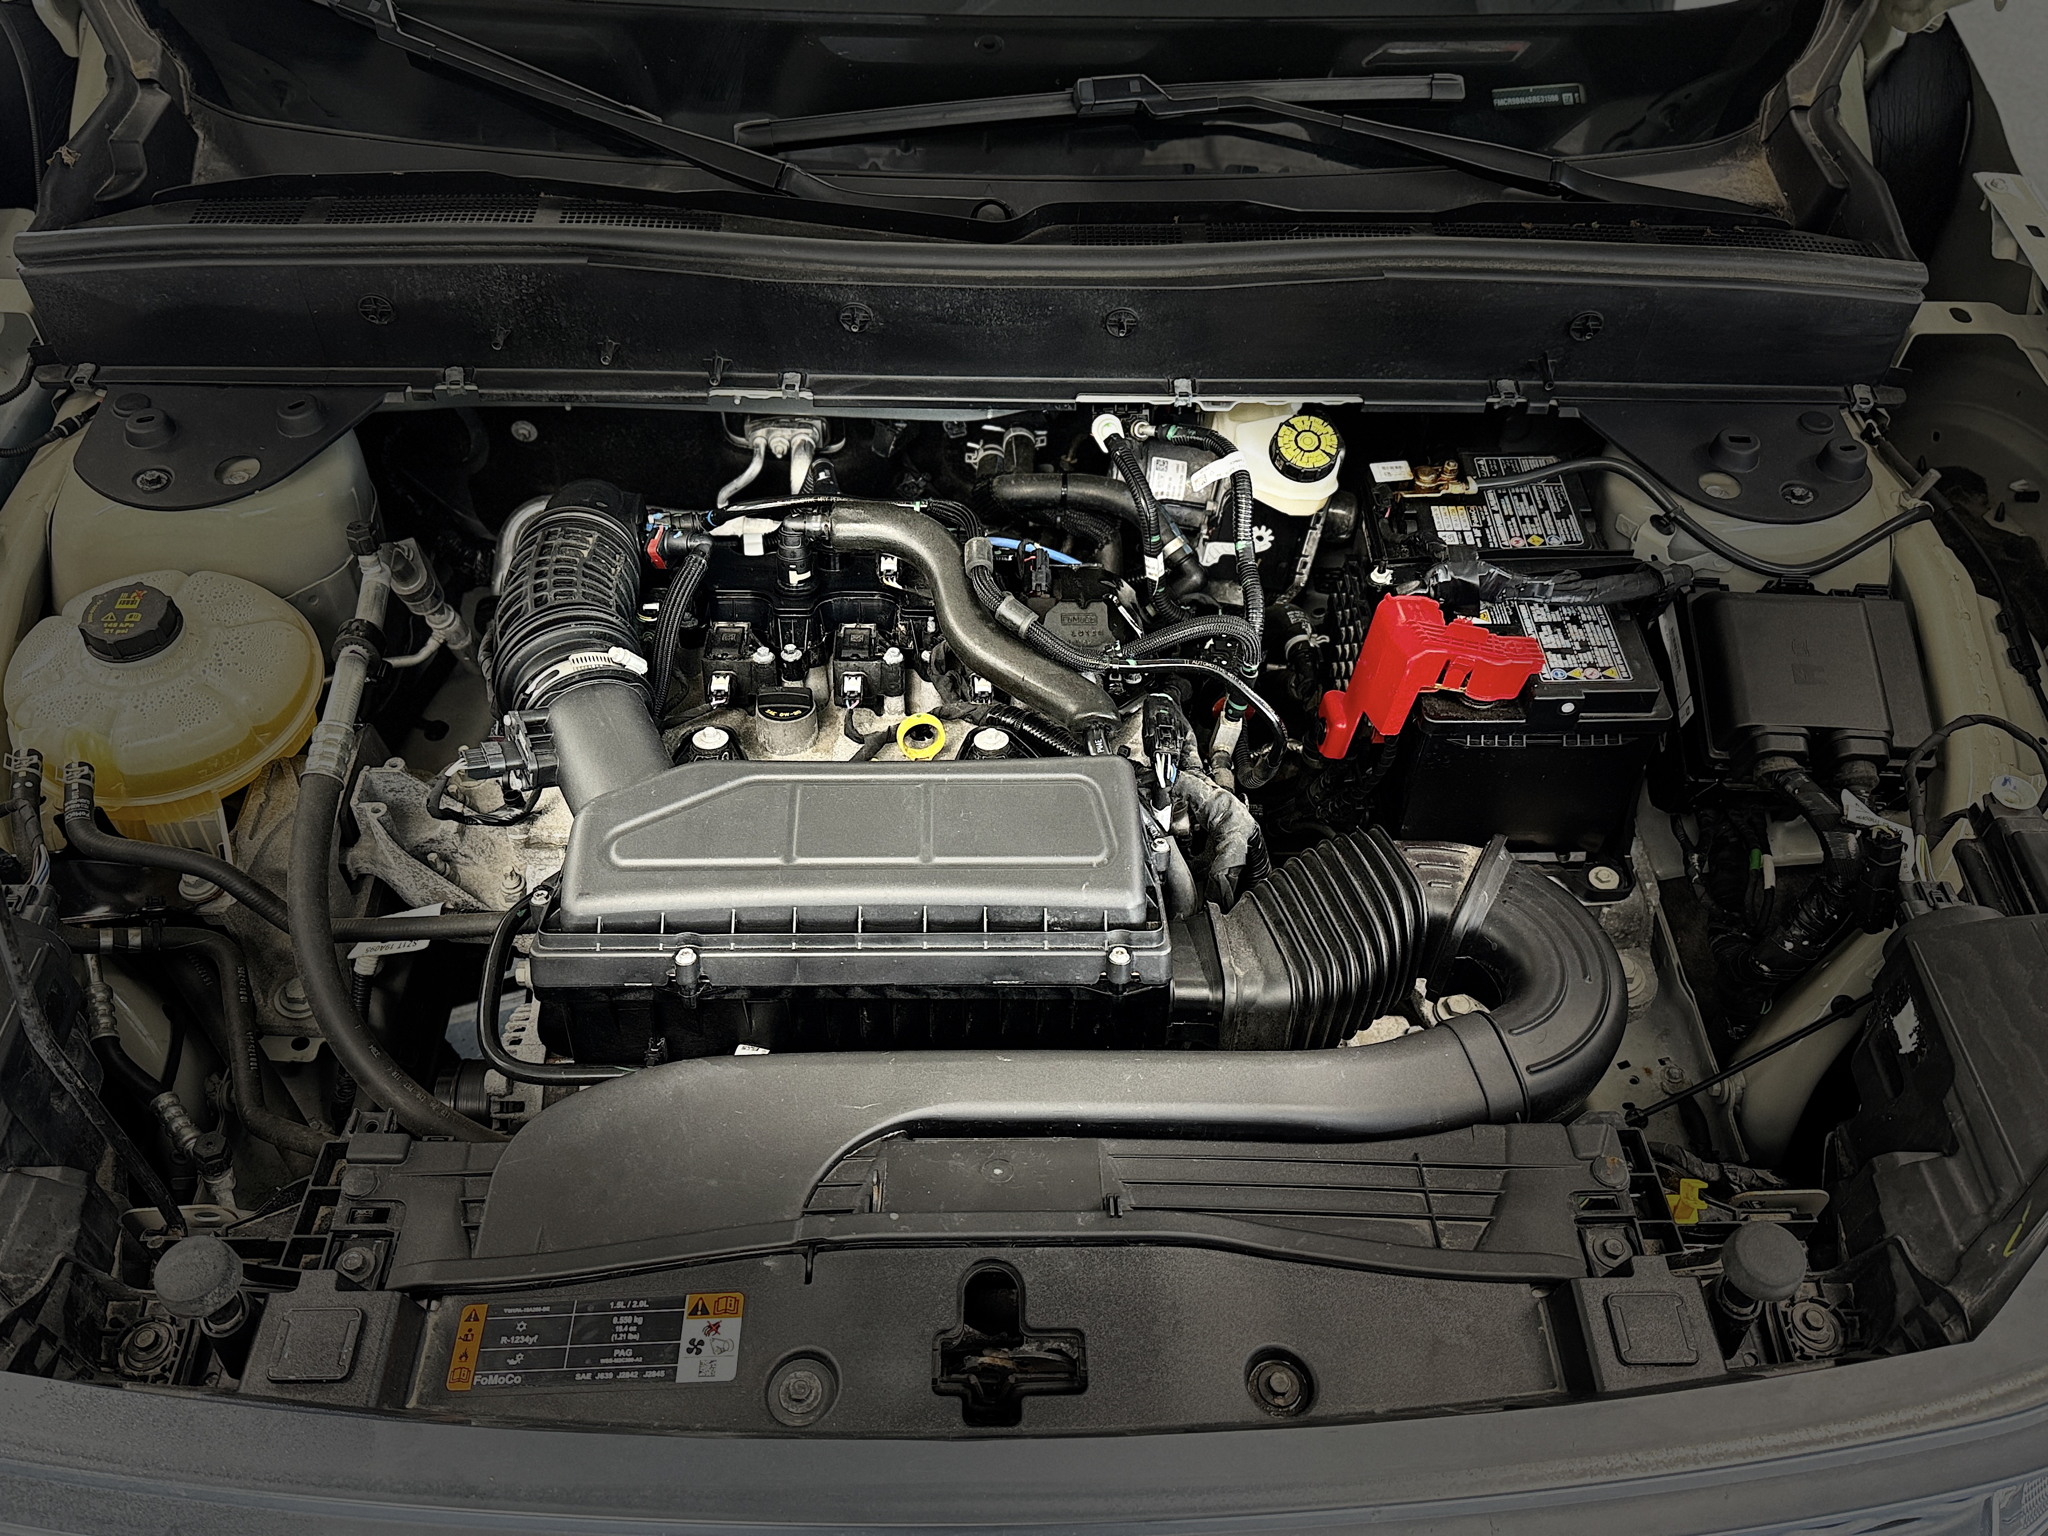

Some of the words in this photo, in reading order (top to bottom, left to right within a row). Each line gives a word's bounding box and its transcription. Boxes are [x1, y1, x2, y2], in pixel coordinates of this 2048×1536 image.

[632, 1299, 650, 1308] 2.0L
[633, 1316, 644, 1325] kg
[500, 1335, 539, 1345] R-1234yf
[613, 1348, 633, 1357] PAG
[473, 1373, 522, 1386] FoMoCo
[575, 1372, 592, 1380] SAE
